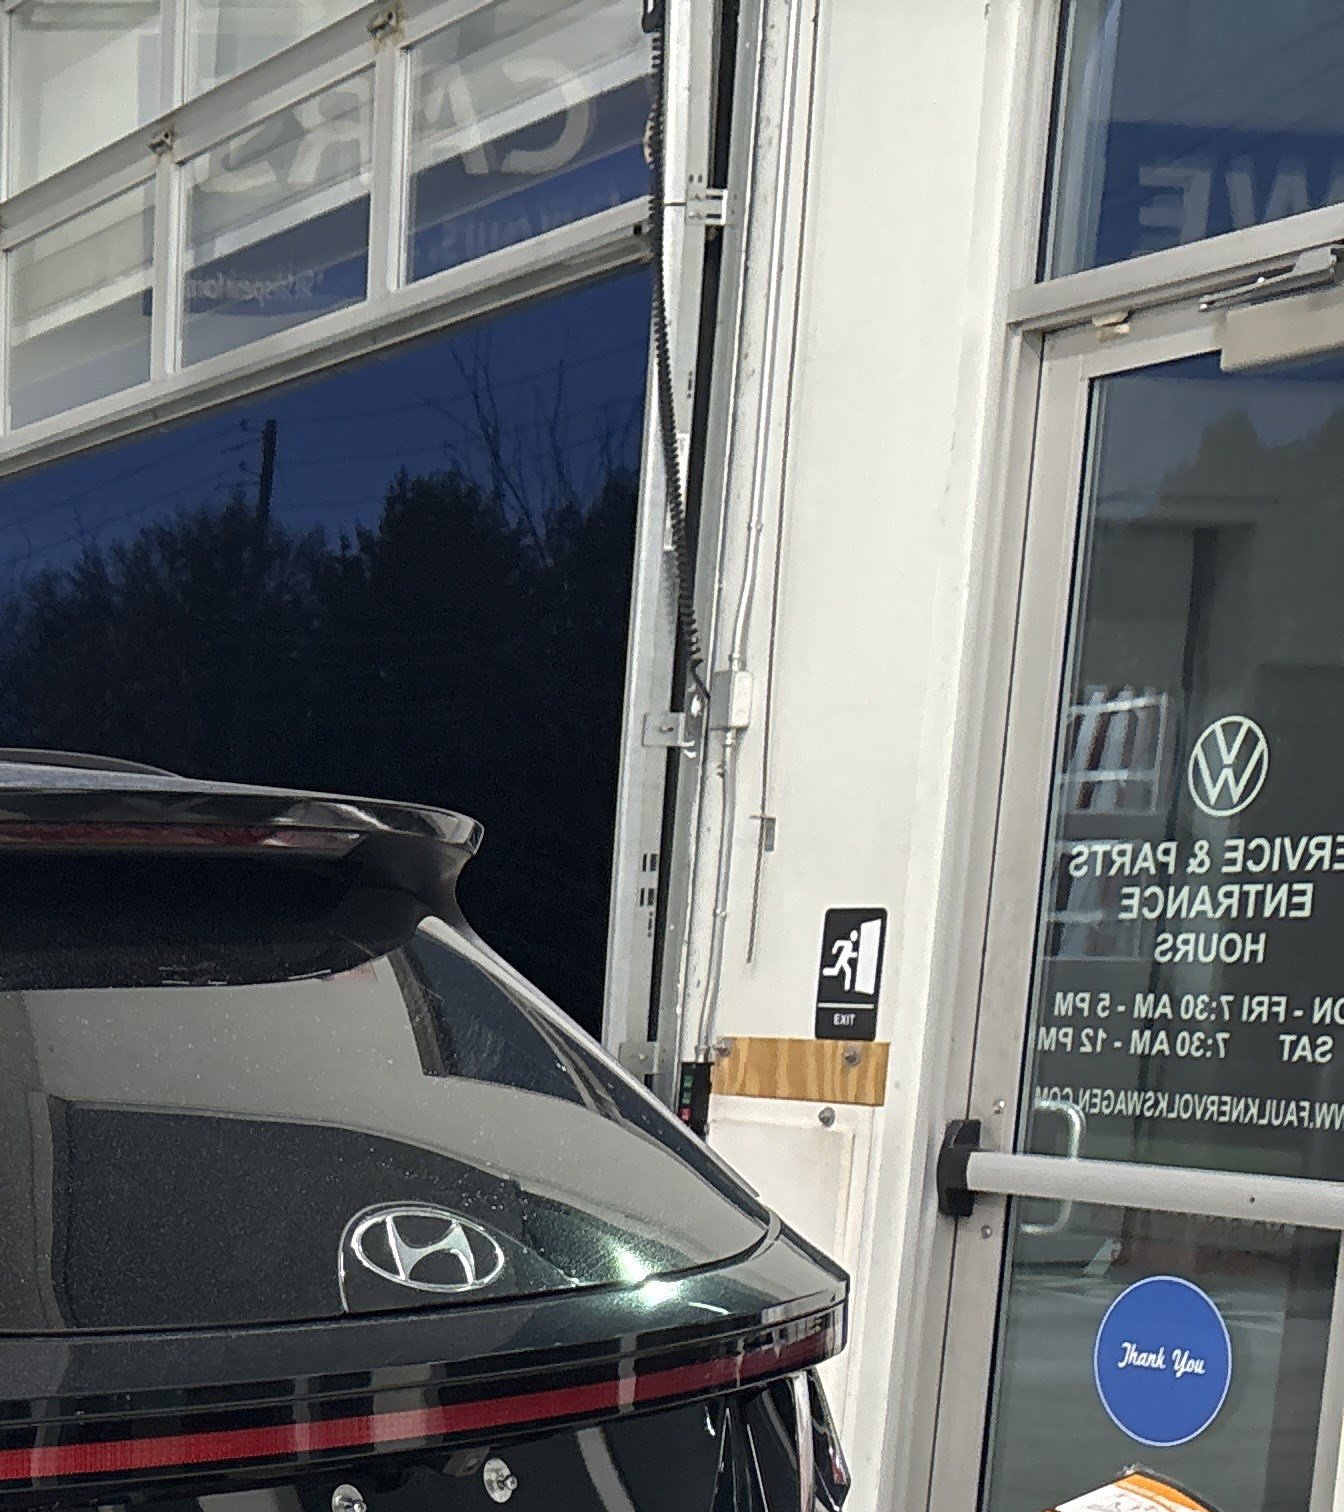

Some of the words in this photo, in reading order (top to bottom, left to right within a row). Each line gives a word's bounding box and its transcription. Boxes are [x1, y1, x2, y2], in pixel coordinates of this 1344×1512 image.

[833, 1012, 856, 1027] EXIT
[1117, 1341, 1167, 1370] Thank
[1171, 1347, 1207, 1378] You
